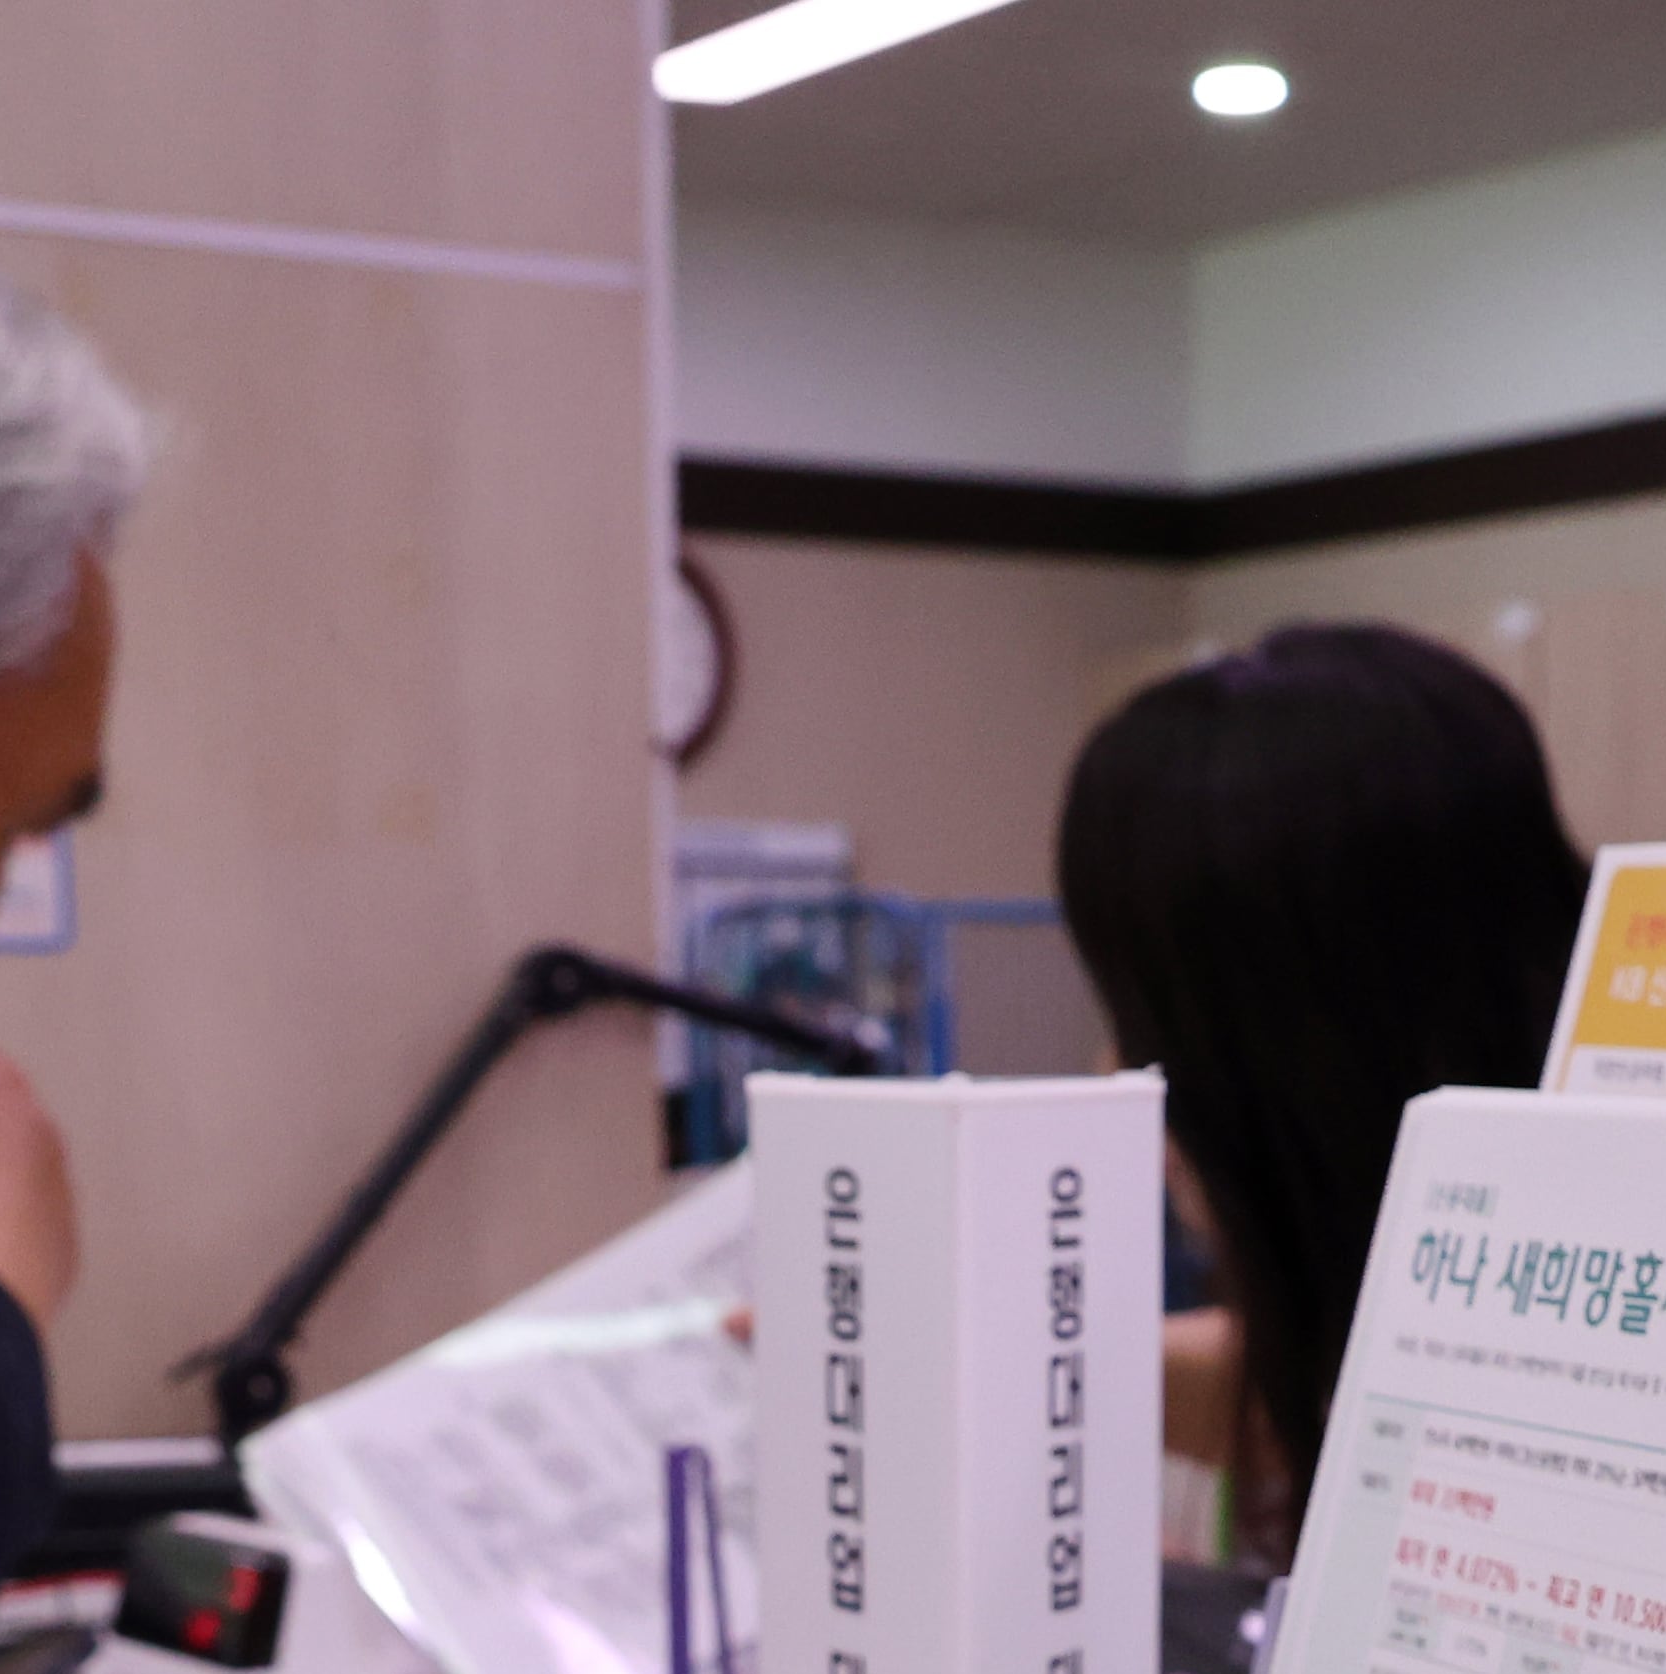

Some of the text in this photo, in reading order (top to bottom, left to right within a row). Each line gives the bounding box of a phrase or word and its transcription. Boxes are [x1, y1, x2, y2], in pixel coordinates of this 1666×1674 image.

[822, 1167, 865, 1614] 은행대리업
[1046, 1167, 1089, 1613] 은행대리업
[1411, 1227, 1489, 1309] 하나
